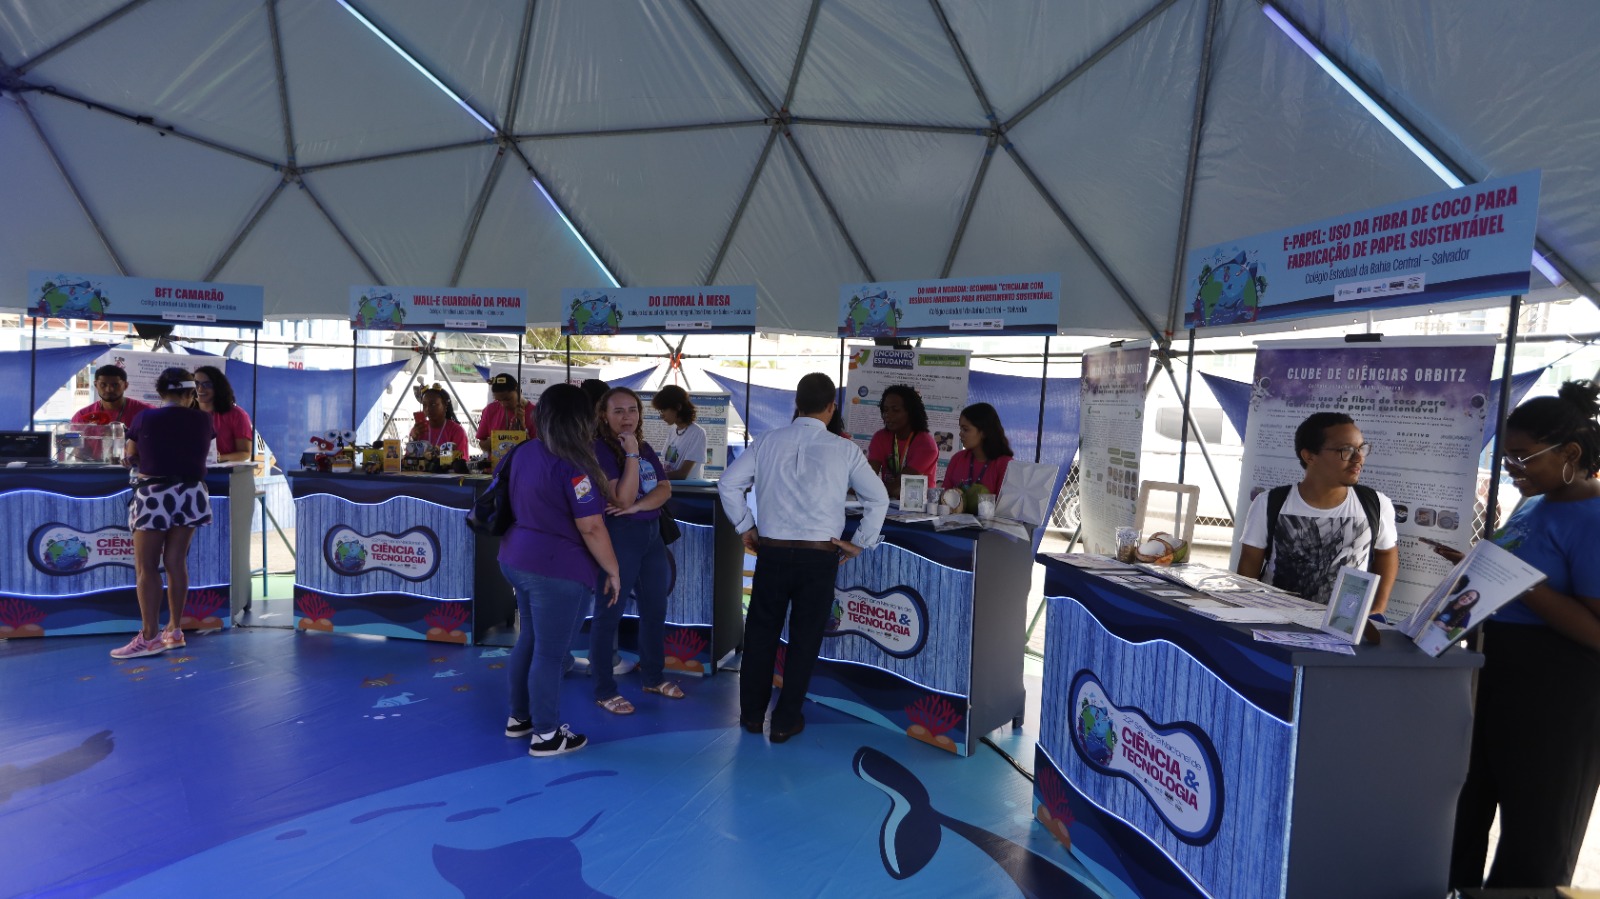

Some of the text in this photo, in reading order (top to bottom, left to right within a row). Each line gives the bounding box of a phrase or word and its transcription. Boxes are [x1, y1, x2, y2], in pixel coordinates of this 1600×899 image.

[1283, 185, 1518, 251] E-PAPEL: USO DA FIBRA DE COCO PARA
[1287, 213, 1505, 269] FABRICAÇÃO DE PAPEL SUSTENTÁVEL
[1329, 264, 1358, 282] Estadual
[1359, 263, 1369, 276] da
[1370, 260, 1391, 274] Bahia
[1392, 254, 1421, 271] Central
[1431, 248, 1471, 266] Salvador
[1030, 281, 1044, 290] COM
[155, 287, 224, 302] BFT CAMARÃO
[413, 293, 521, 308] WALL-E GUARDIÃO DA PRAIA
[648, 292, 731, 307] DO LITORAL À MESA
[961, 294, 975, 303] PARA
[975, 292, 1015, 302] REVESTIMENTO
[1016, 291, 1053, 301] SUSTENTÁVEL
[873, 349, 915, 359] ENCONTRO
[873, 357, 914, 366] ESTUDANTIL
[1287, 365, 1467, 382] CLUBE DE CIÊNCIAS ORBITZ
[1333, 402, 1345, 410] de
[1348, 403, 1376, 413] papel
[1378, 404, 1438, 414] sustentável
[1336, 395, 1348, 403] da
[1351, 395, 1376, 404] fibra
[1379, 396, 1390, 405] de
[1393, 398, 1417, 406] coco
[1420, 399, 1447, 408] para
[96, 548, 135, 556] TECNO
[371, 542, 427, 556] CIÊNCIA &
[371, 553, 427, 564] TECNOLOGIA
[847, 600, 911, 627] CIÊNCIA &
[847, 612, 911, 637] TECNOLOGIA
[1121, 726, 1199, 793] CIÊNCIA &
[1121, 743, 1198, 810] TECNOLOGIA
